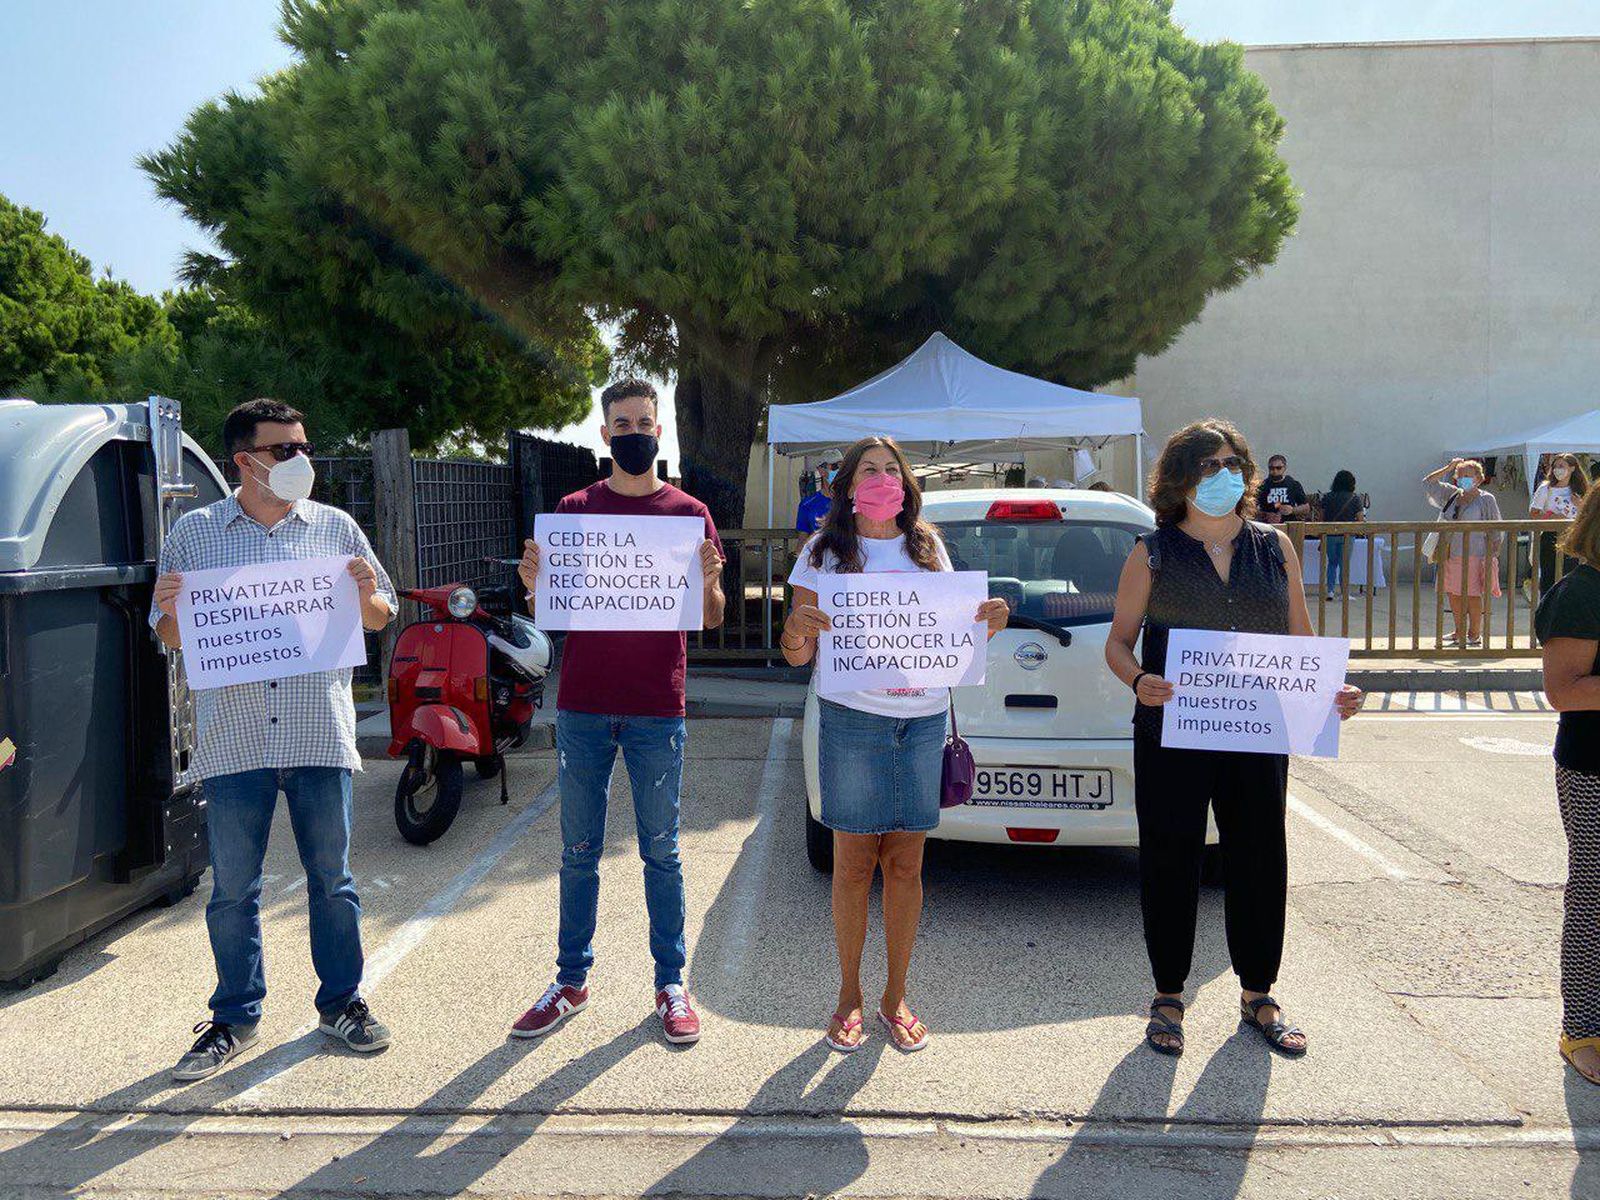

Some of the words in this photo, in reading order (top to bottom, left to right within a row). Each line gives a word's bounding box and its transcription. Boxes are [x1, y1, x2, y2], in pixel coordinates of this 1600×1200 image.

[1267, 495, 1279, 503] DO
[1268, 487, 1288, 496] JUST
[548, 532, 607, 547] CEDER
[615, 533, 636, 547] LA
[549, 551, 626, 568] GESTIÓN
[635, 555, 653, 568] ES
[190, 579, 305, 605] PRIVATIZAR
[313, 575, 333, 591] ES
[550, 574, 660, 588] RECONOCER
[668, 575, 689, 589] LA
[549, 596, 675, 610] INCAPACIDAD
[832, 591, 891, 607] CEDER
[898, 591, 920, 605] LA
[194, 596, 335, 627] DESPILFARRAR
[832, 610, 910, 629] GESTIÓN
[919, 612, 937, 627] ES
[198, 626, 282, 649] nuestros
[833, 634, 943, 650] RECONOCER
[952, 633, 973, 647] LA
[200, 645, 302, 671] impuestos
[834, 654, 958, 671] INCAPACIDAD
[1181, 650, 1292, 670] PRIVATIZAR
[1300, 656, 1320, 671] ES
[1179, 672, 1317, 692] DESPILFARRAR
[1178, 696, 1257, 711] nuestros
[1177, 715, 1272, 734] impuestos
[977, 771, 1042, 796] 9569
[1053, 774, 1102, 799] HTJ
[976, 799, 1090, 810] www.nissanbaleares.com
